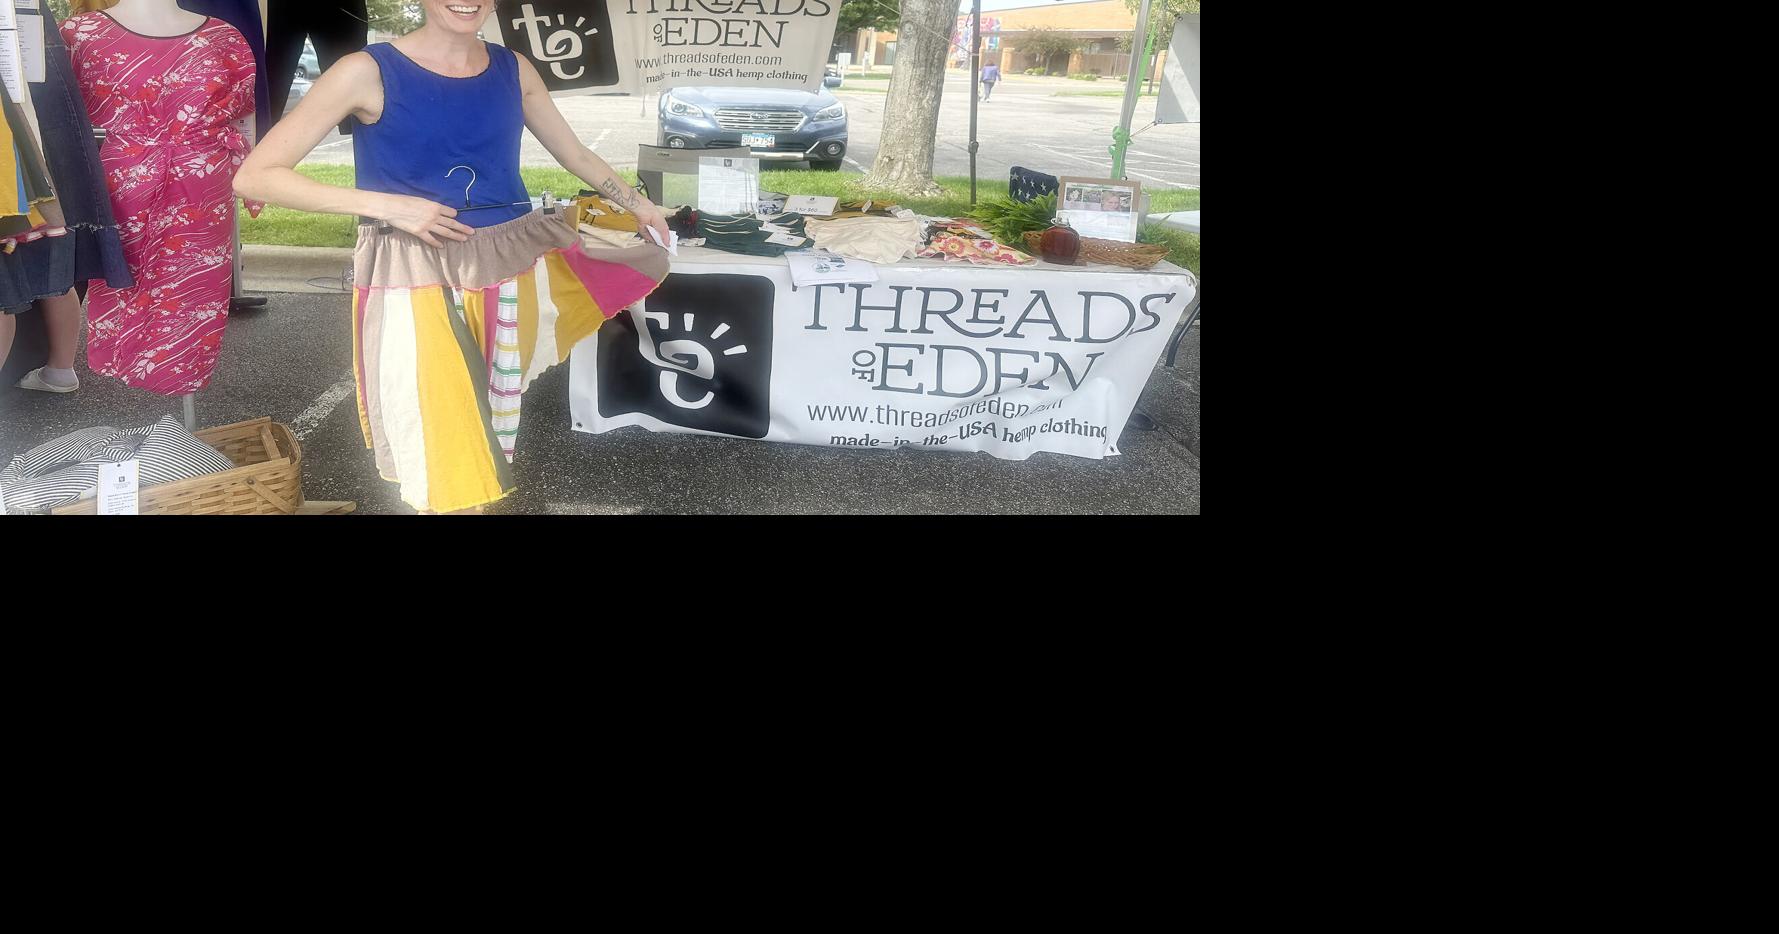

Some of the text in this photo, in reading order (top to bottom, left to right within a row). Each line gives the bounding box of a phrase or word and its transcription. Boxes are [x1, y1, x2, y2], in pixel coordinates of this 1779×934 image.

[661, 17, 789, 48] EDEN
[634, 52, 782, 68] wwwthreadsofeden.com
[736, 69, 764, 81] hemp
[766, 69, 808, 84] clothing
[792, 283, 1176, 344] THREADS
[872, 342, 1105, 398] EDEN
[807, 397, 1063, 428] www.threadsofedenom
[1002, 425, 1036, 442] hemp
[1039, 417, 1108, 444] clothing
